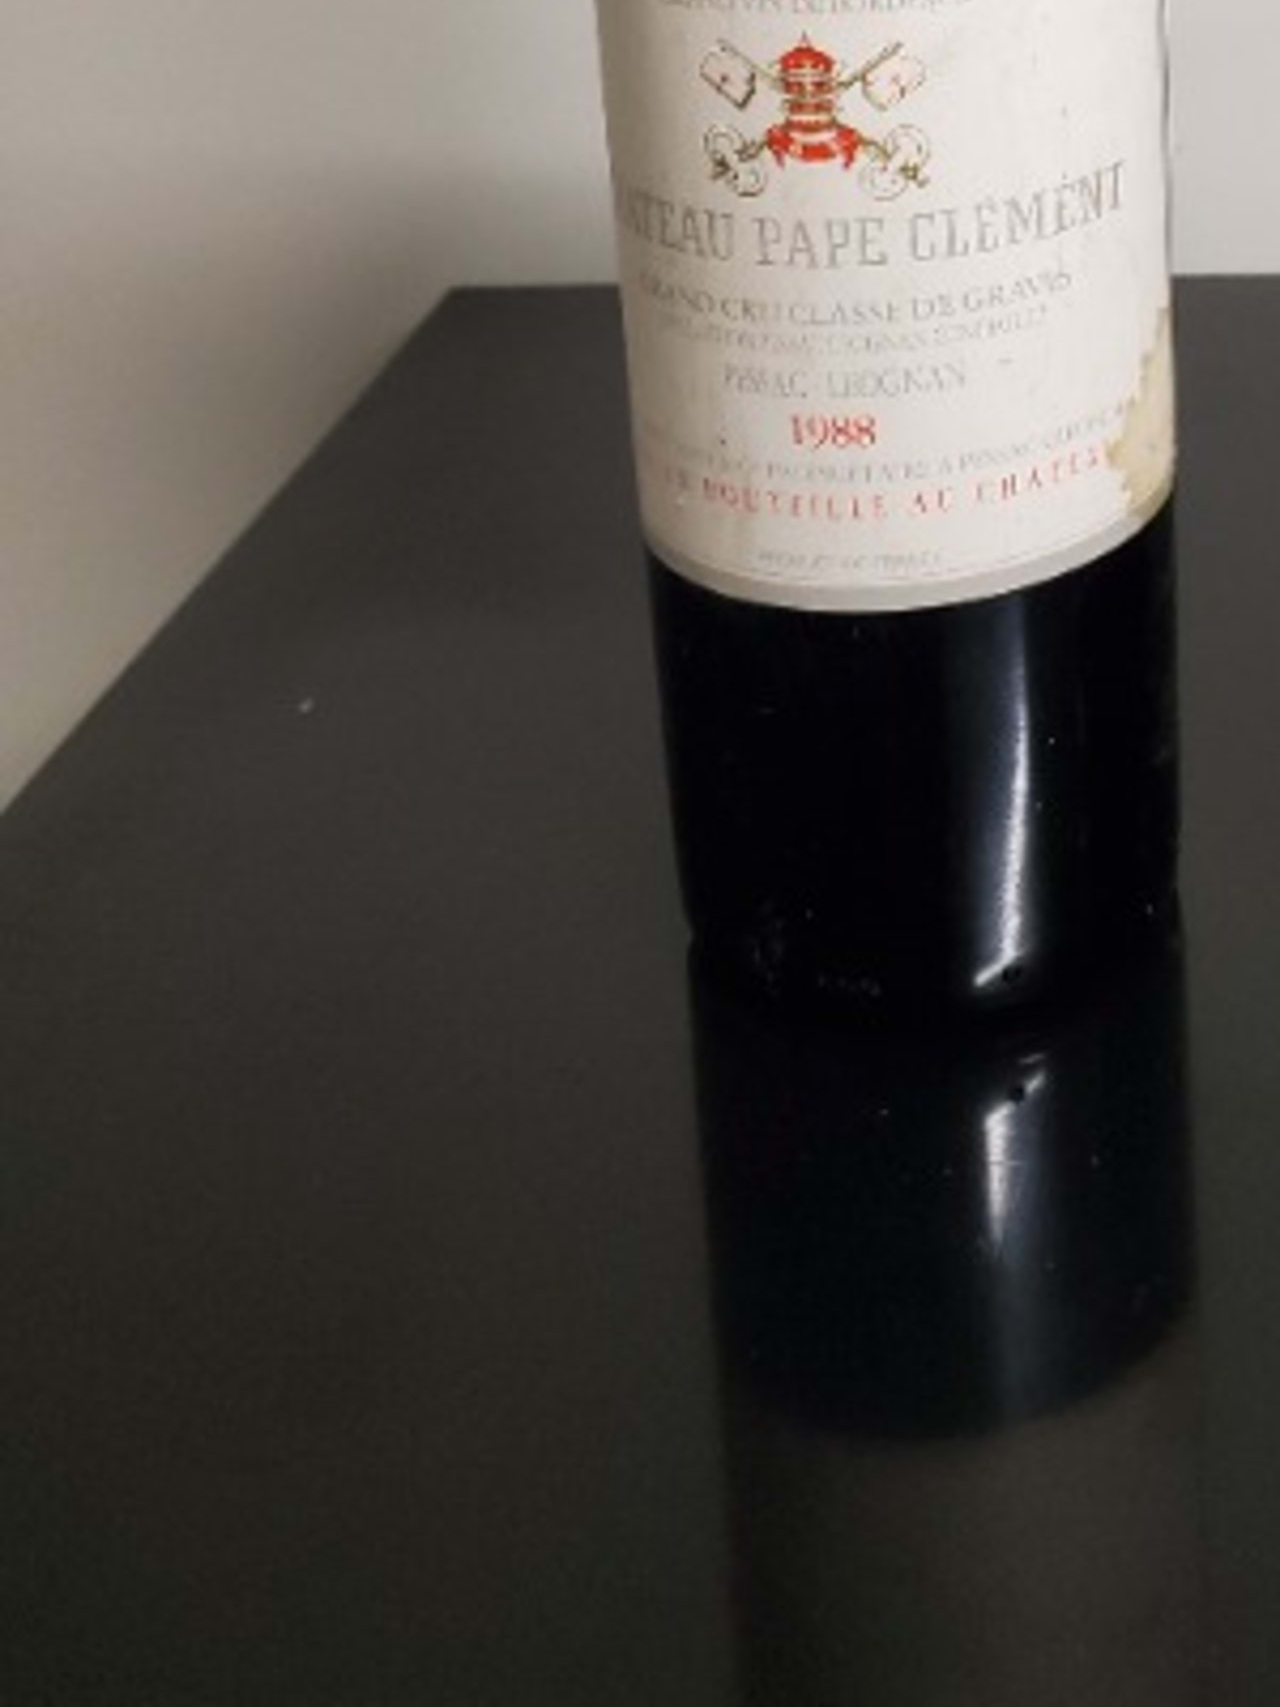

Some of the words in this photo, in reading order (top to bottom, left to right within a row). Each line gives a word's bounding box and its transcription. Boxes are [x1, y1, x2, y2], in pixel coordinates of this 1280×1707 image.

[752, 216, 888, 269] PAPE
[790, 413, 877, 449] 1988
[912, 490, 953, 516] AU
